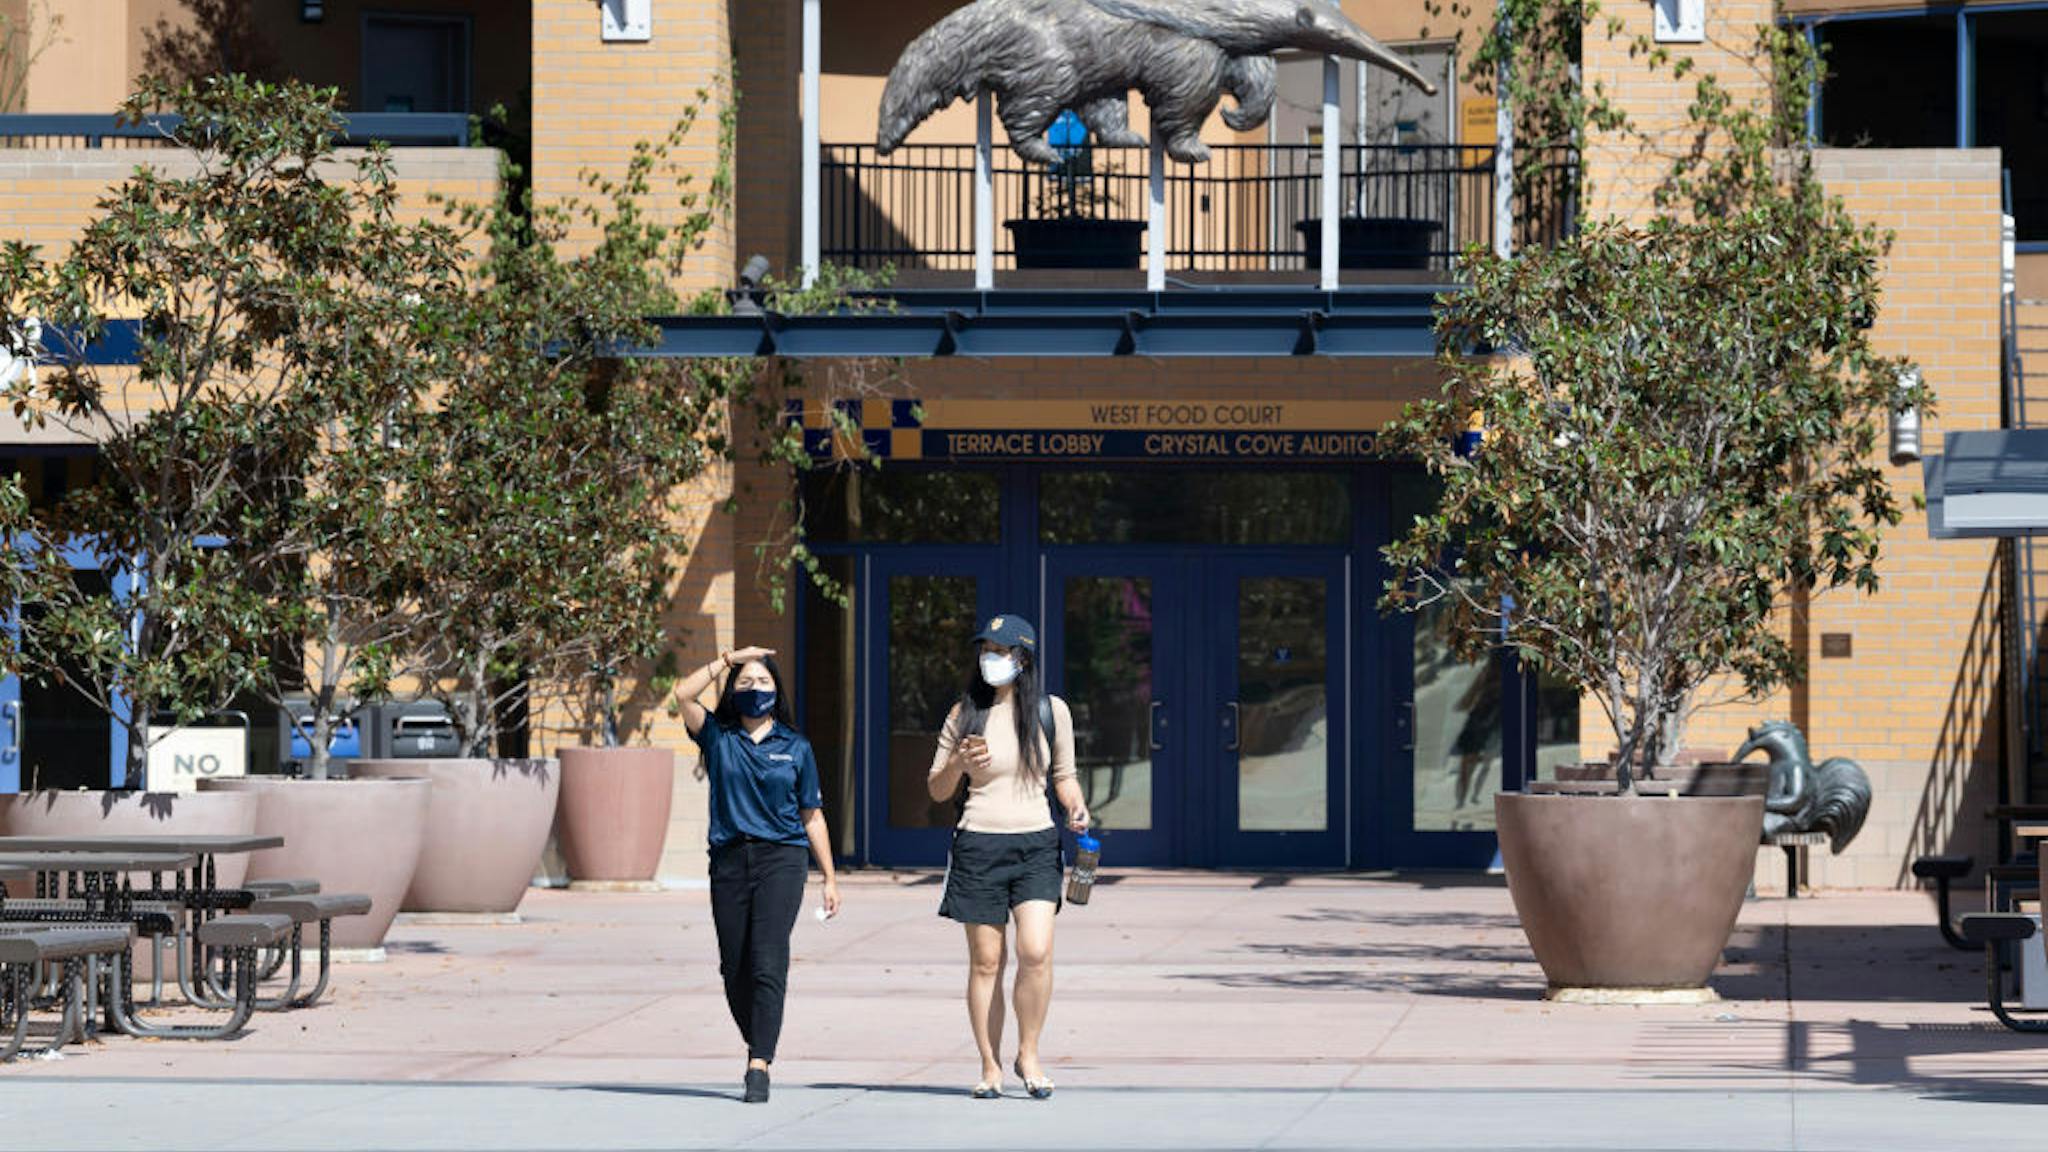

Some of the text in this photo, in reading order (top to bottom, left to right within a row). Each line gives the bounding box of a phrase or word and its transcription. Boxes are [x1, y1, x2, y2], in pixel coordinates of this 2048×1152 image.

[1090, 405, 1283, 424] WEST FOOD COURT
[947, 433, 1104, 455] TERRACE LOBBY
[1144, 433, 1383, 455] CRYSTAL COVE AUDITO
[174, 753, 220, 775] NO
